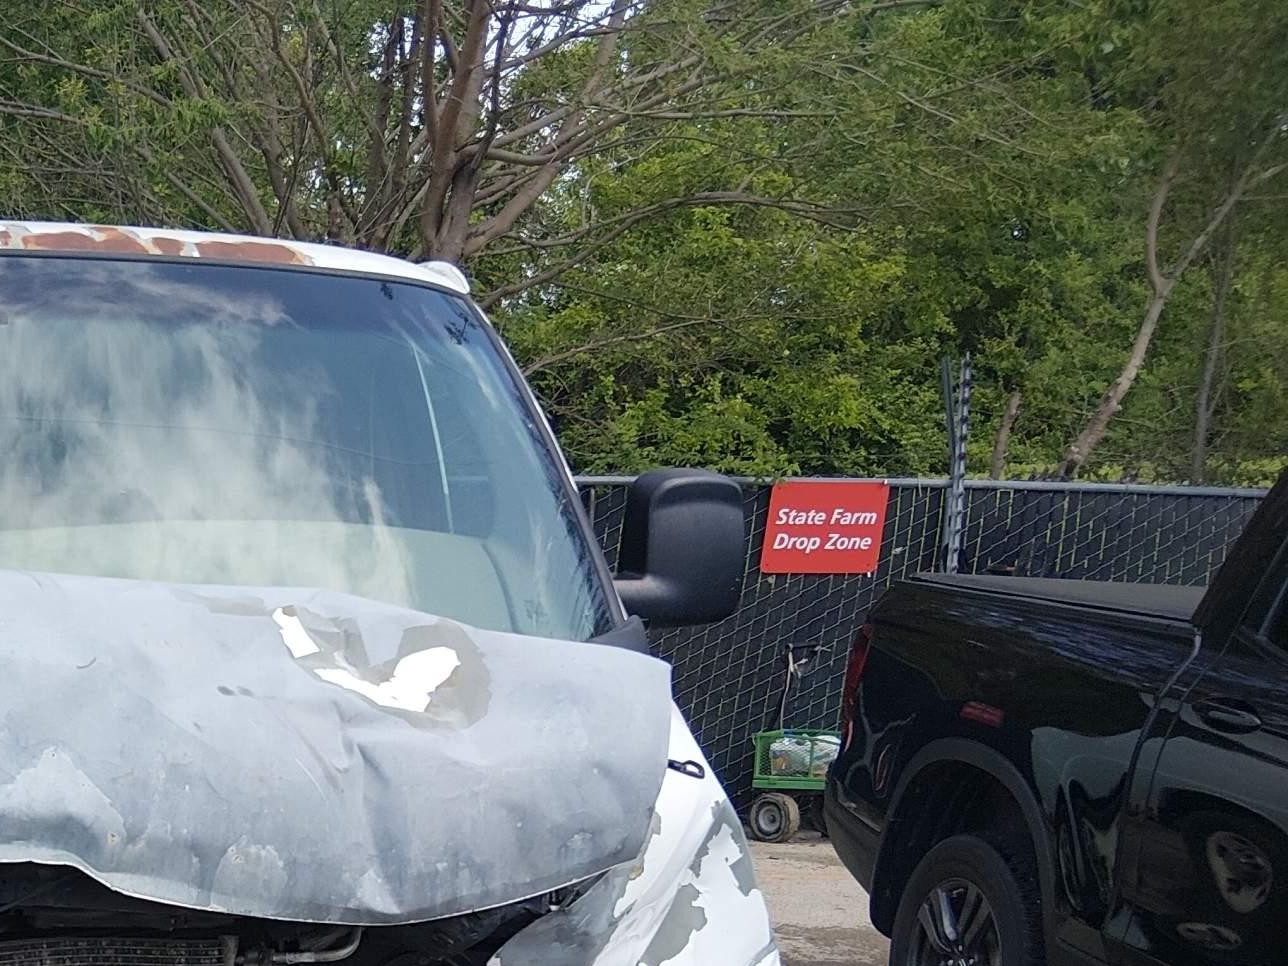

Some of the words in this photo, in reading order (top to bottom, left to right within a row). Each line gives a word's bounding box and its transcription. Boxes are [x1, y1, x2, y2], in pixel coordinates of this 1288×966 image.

[775, 508, 827, 525] State
[830, 508, 877, 525] Farm
[773, 533, 821, 554] Drop
[824, 533, 872, 550] Zone
